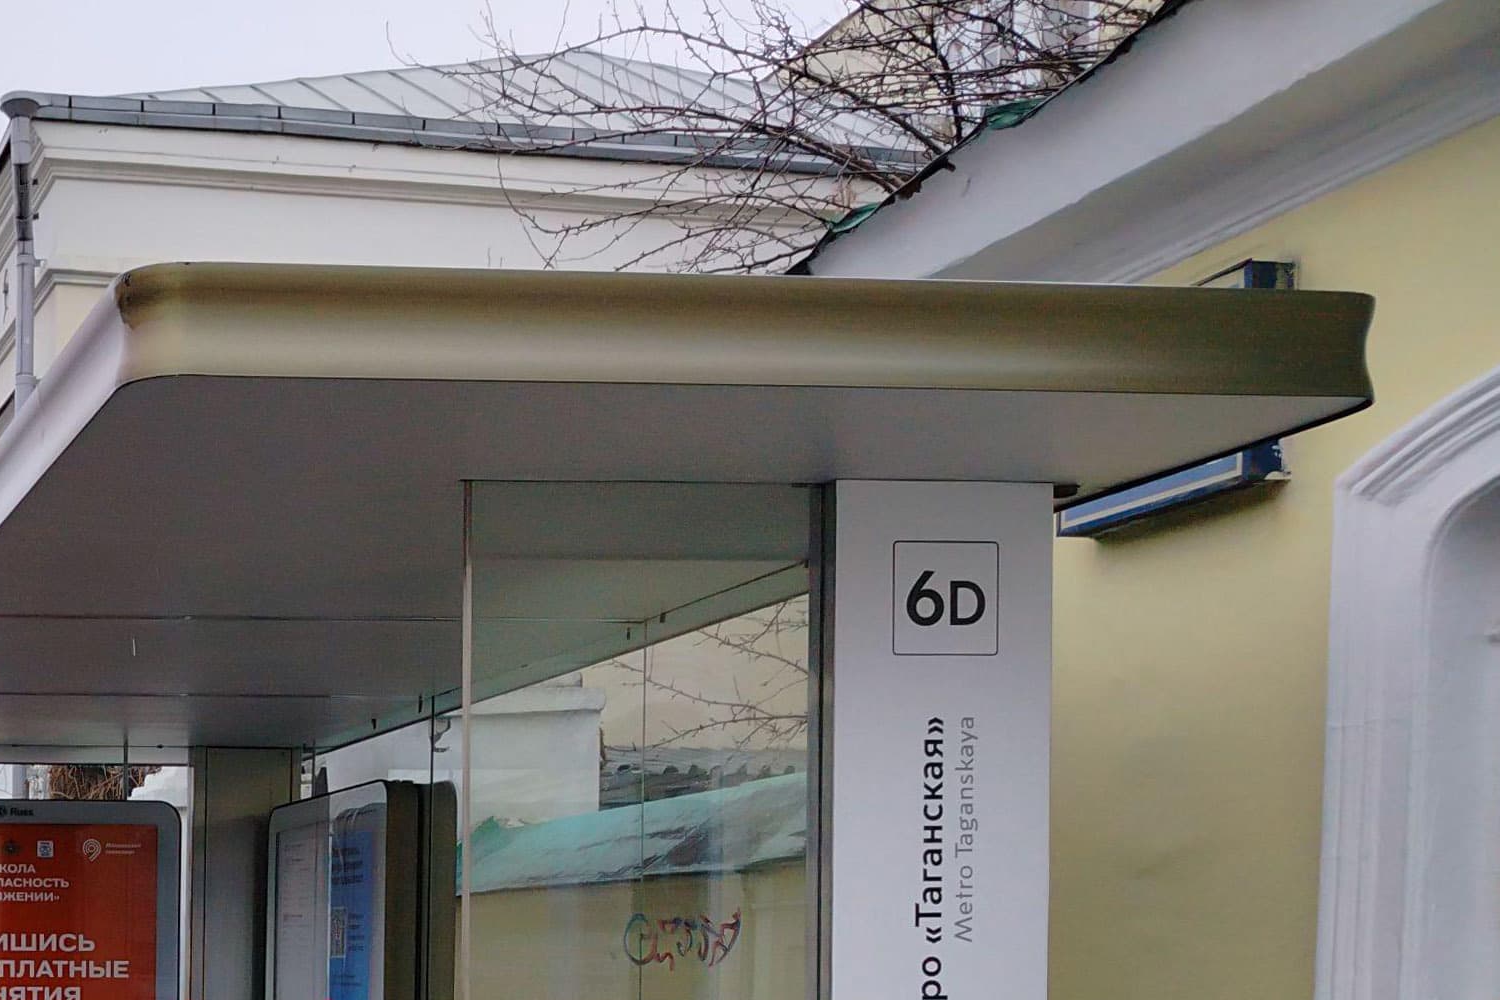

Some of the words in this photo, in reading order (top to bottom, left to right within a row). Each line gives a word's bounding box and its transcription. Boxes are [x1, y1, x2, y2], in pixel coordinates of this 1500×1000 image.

[906, 570, 986, 626] 6D
[915, 716, 944, 944] «Таганская»
[954, 716, 979, 858] Taganskaya
[954, 865, 974, 943] Metro
